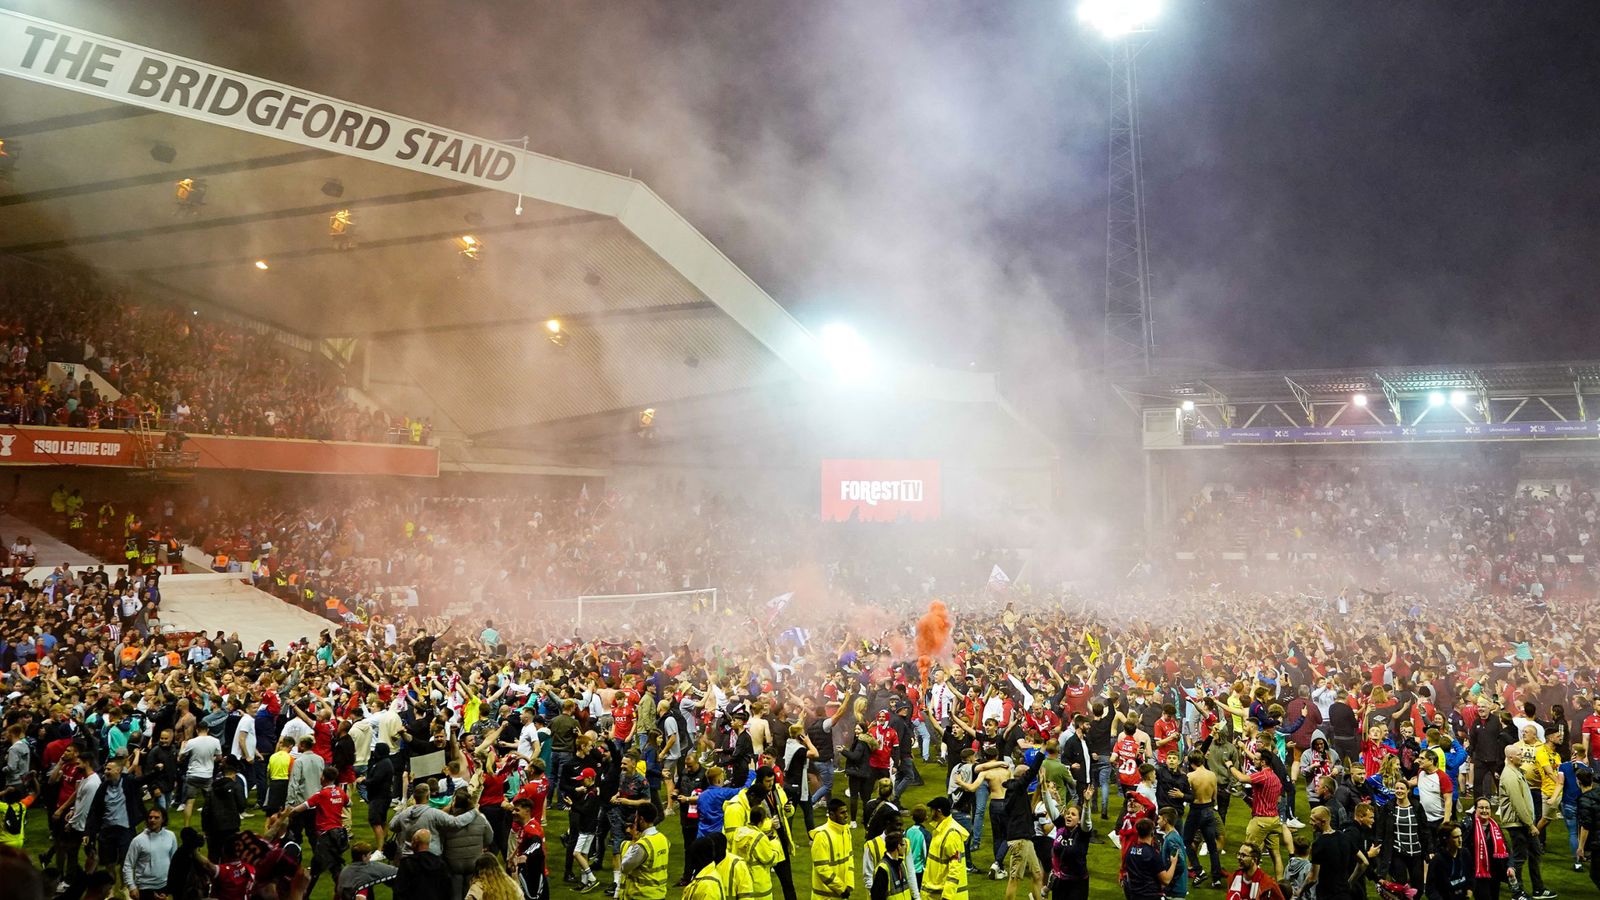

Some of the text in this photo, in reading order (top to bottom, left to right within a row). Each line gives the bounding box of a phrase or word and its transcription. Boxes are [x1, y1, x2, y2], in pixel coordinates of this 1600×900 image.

[20, 25, 517, 183] THE BRIDGFORD STAND
[33, 440, 121, 457] 1990 LEAGUE CUP
[902, 481, 921, 500] TV
